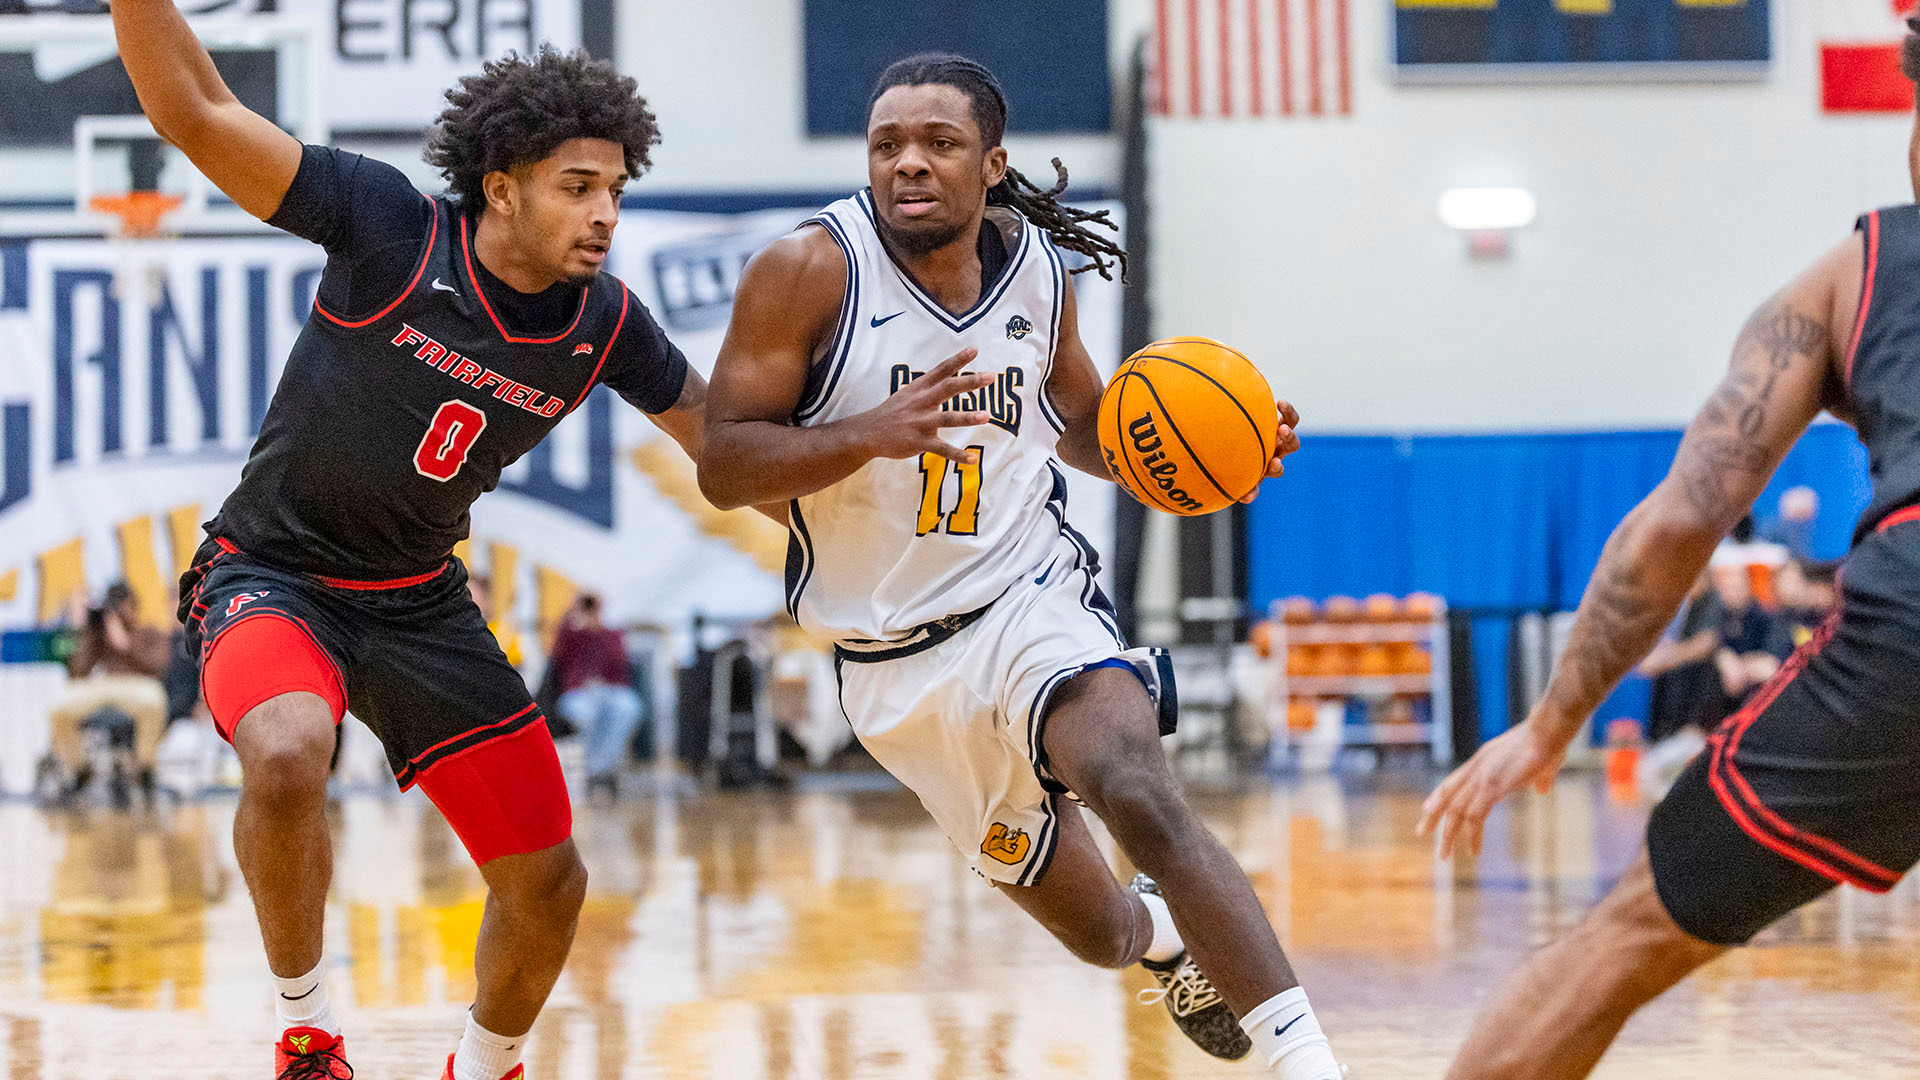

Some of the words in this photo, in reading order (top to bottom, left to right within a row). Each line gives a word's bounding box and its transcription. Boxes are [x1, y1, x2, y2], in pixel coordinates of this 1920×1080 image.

[391, 322, 566, 418] FAIRFIELD
[413, 399, 487, 482] 0
[1129, 411, 1203, 511] Wilson
[915, 445, 984, 537] 11
